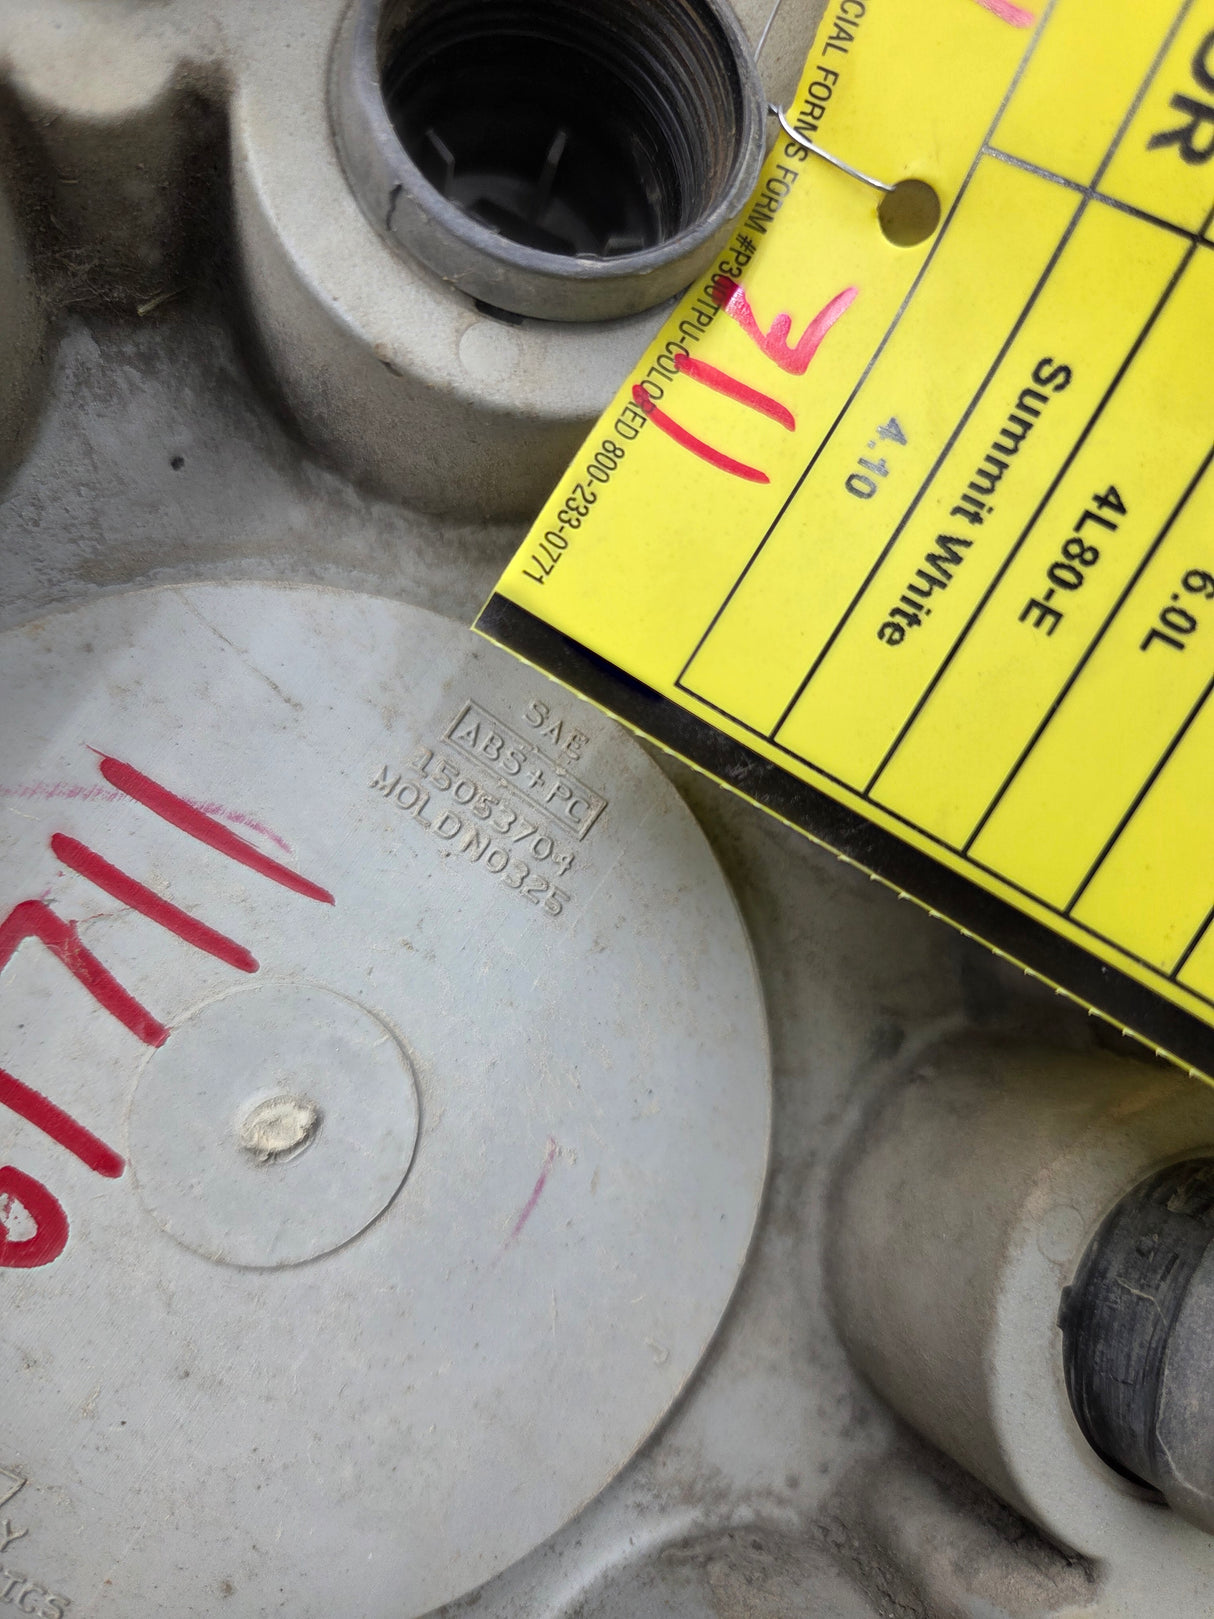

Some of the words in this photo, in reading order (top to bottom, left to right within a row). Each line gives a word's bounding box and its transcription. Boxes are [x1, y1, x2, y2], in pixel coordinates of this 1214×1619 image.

[822, 0, 866, 56] CIAL
[784, 65, 840, 163] FORMS
[743, 164, 799, 235] FORM
[844, 416, 908, 500] 4.10
[949, 357, 1073, 526] Summit
[522, 439, 626, 585] 800-233-0771
[1017, 484, 1128, 637] 4L80-E
[876, 533, 974, 647] White
[1139, 568, 1214, 651] 6.0L
[456, 721, 593, 824] ABS+PC
[521, 698, 591, 762] SAE
